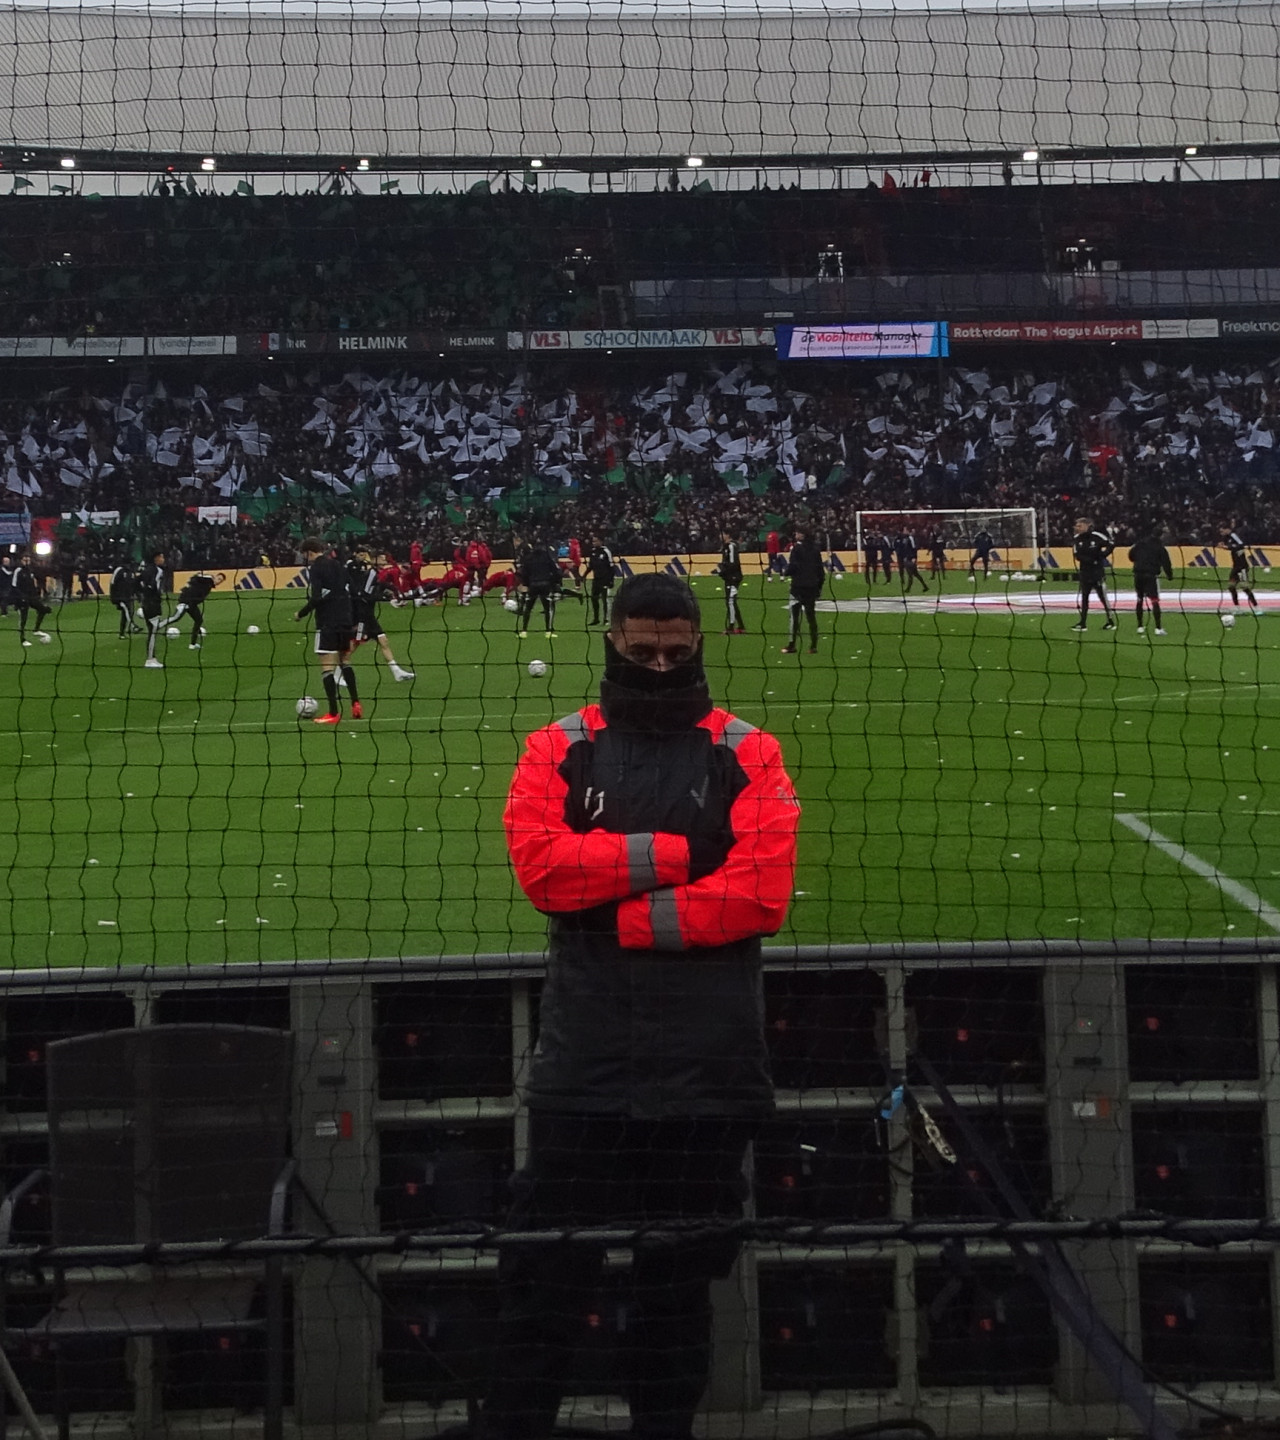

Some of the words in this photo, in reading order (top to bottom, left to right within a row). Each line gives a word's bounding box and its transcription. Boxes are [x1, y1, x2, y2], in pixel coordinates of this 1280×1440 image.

[534, 332, 562, 347] VLS
[583, 330, 702, 347] SCHOONMAAK
[713, 329, 742, 345] VLS
[953, 327, 1021, 338] Rotterdam
[1024, 326, 1048, 337] The
[1093, 324, 1138, 338] Airport
[339, 336, 409, 350] HELMINK
[449, 337, 495, 347] HELMINK
